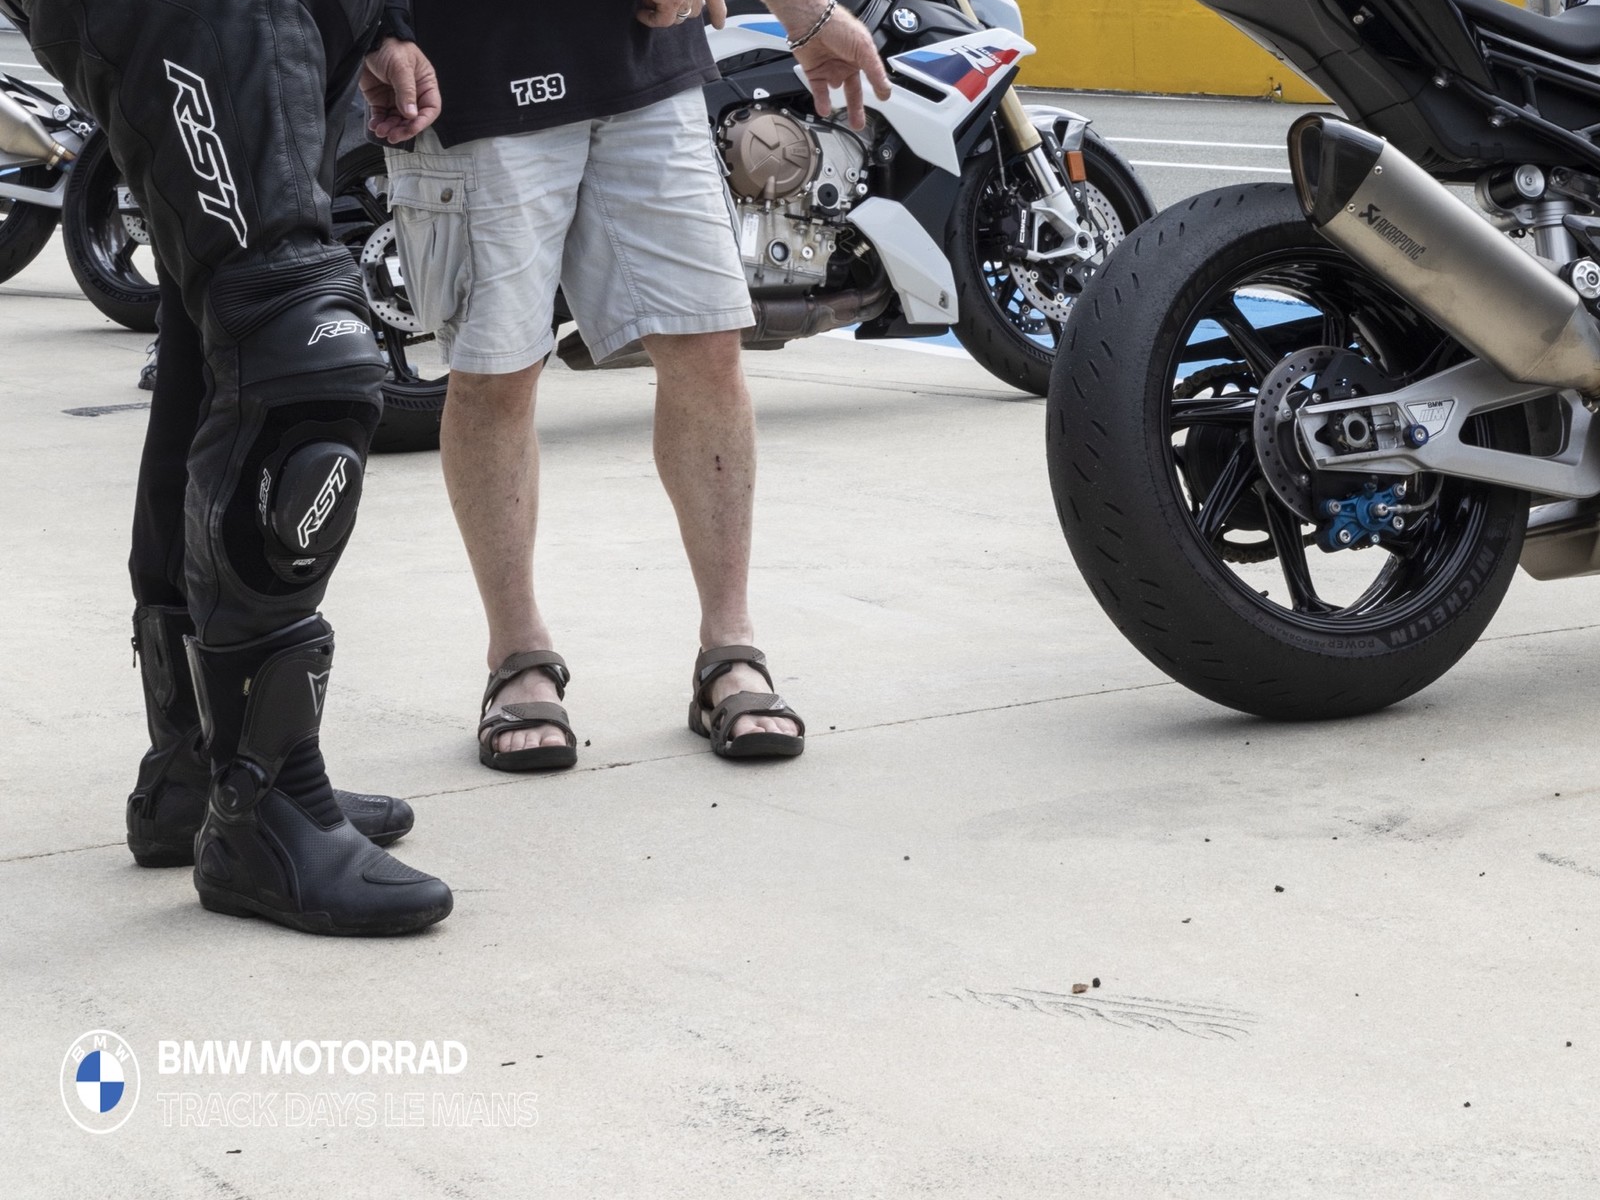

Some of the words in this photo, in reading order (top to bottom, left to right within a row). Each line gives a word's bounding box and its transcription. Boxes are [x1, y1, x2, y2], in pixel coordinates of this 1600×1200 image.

[510, 73, 566, 106] 769
[163, 59, 248, 249] RST
[307, 320, 370, 345] RST
[297, 456, 347, 548] RST
[1390, 545, 1495, 646] MICHELIN
[1328, 639, 1375, 649] POWER
